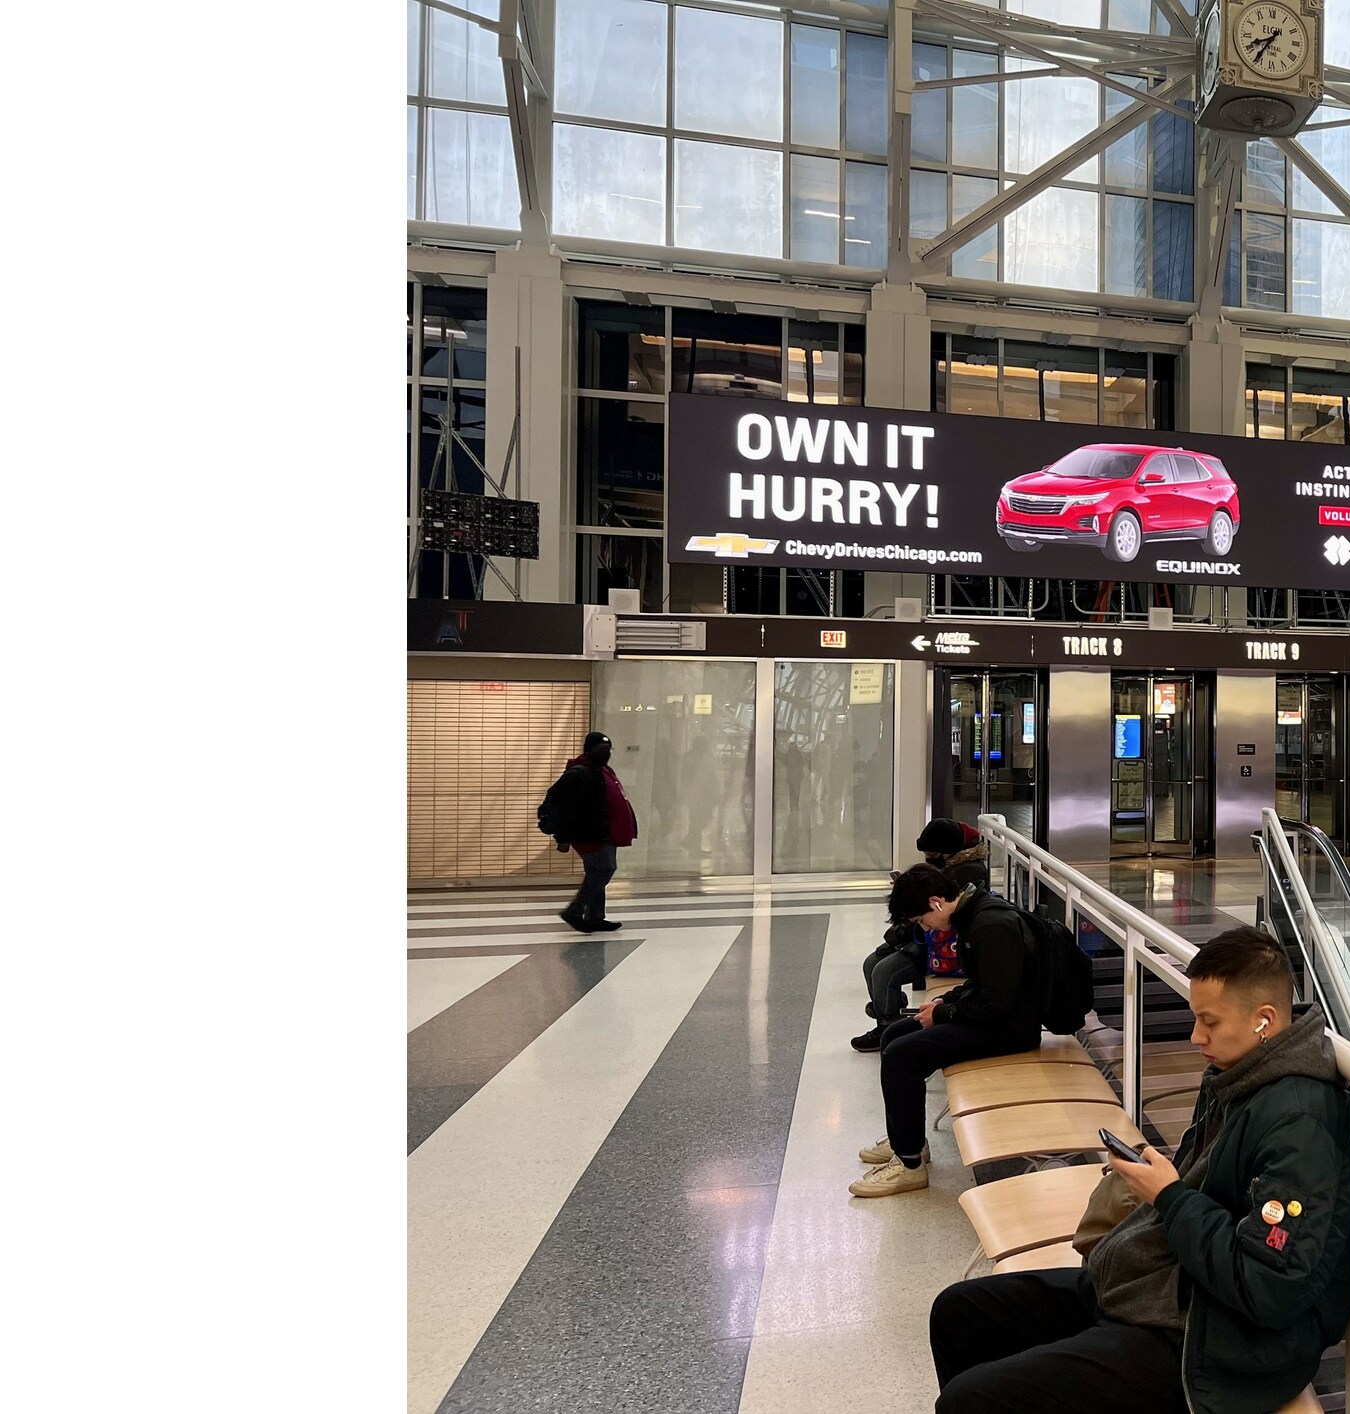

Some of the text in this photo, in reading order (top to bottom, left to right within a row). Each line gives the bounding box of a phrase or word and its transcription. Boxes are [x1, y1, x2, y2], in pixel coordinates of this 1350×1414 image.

[1261, 44, 1282, 53] CNTRAL
[737, 413, 935, 470] OWN IT
[729, 472, 939, 529] HURRY!
[785, 539, 983, 565] ChevyDrivesChicago.com
[1155, 559, 1242, 576] EQUINOX
[822, 631, 844, 643] EXIT
[934, 631, 972, 645] Metra
[1062, 636, 1123, 656] TRACK 8
[934, 644, 971, 654] Tickets
[1245, 641, 1300, 660] TRACK 9
